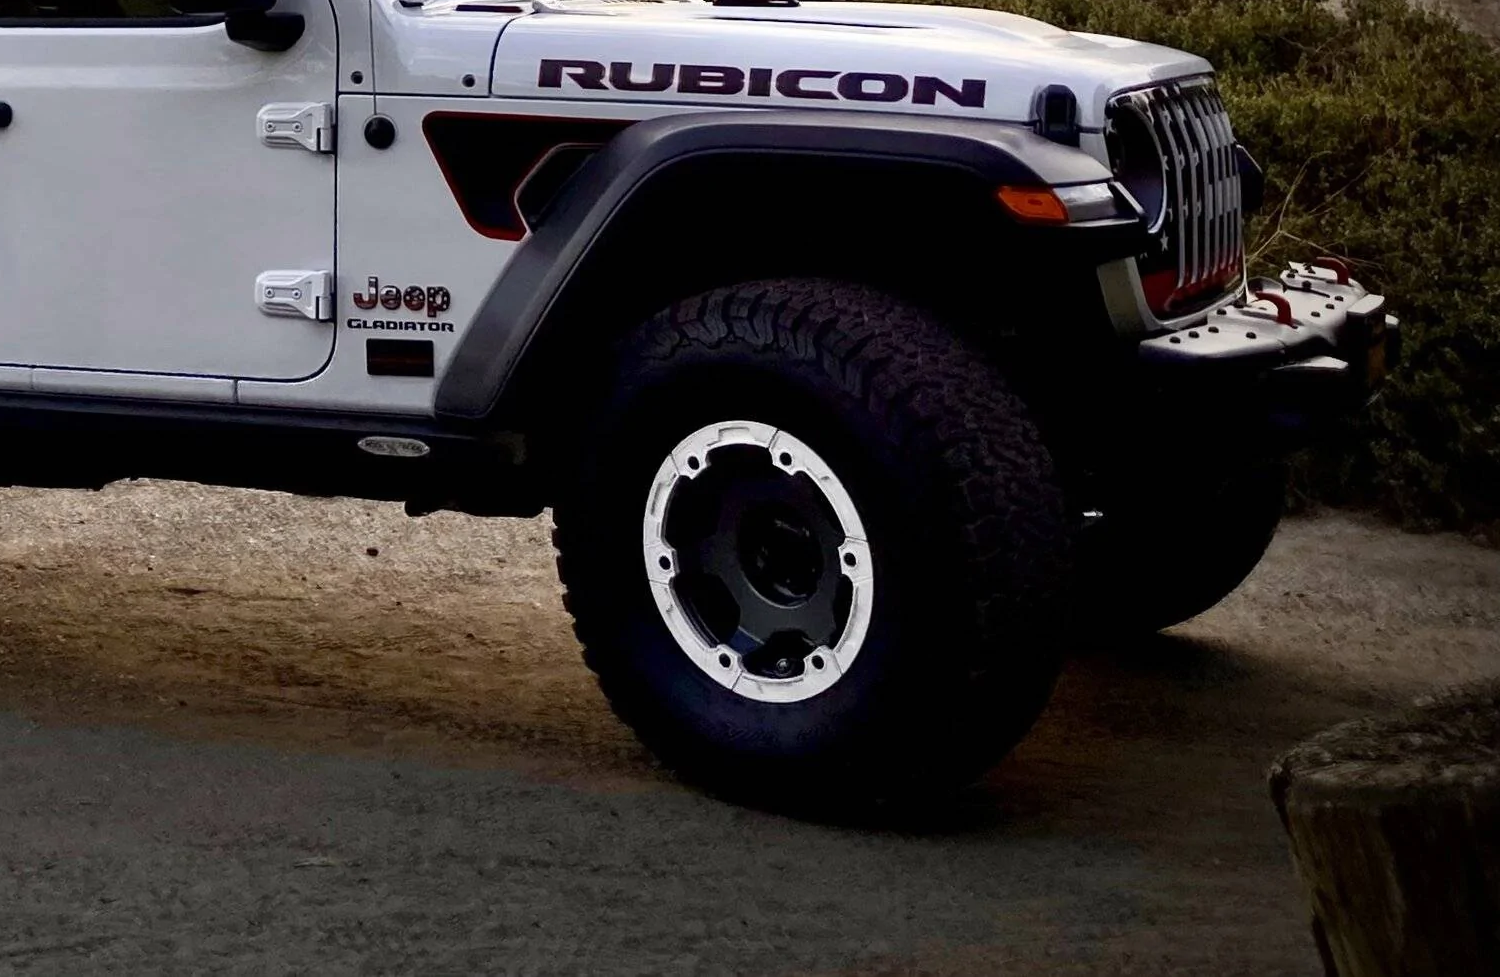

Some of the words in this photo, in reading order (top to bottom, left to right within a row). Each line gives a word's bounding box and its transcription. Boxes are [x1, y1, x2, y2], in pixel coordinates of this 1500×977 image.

[538, 59, 987, 108] RUBICON
[353, 276, 451, 318] Jeep
[347, 319, 455, 332] GLADIATOR
